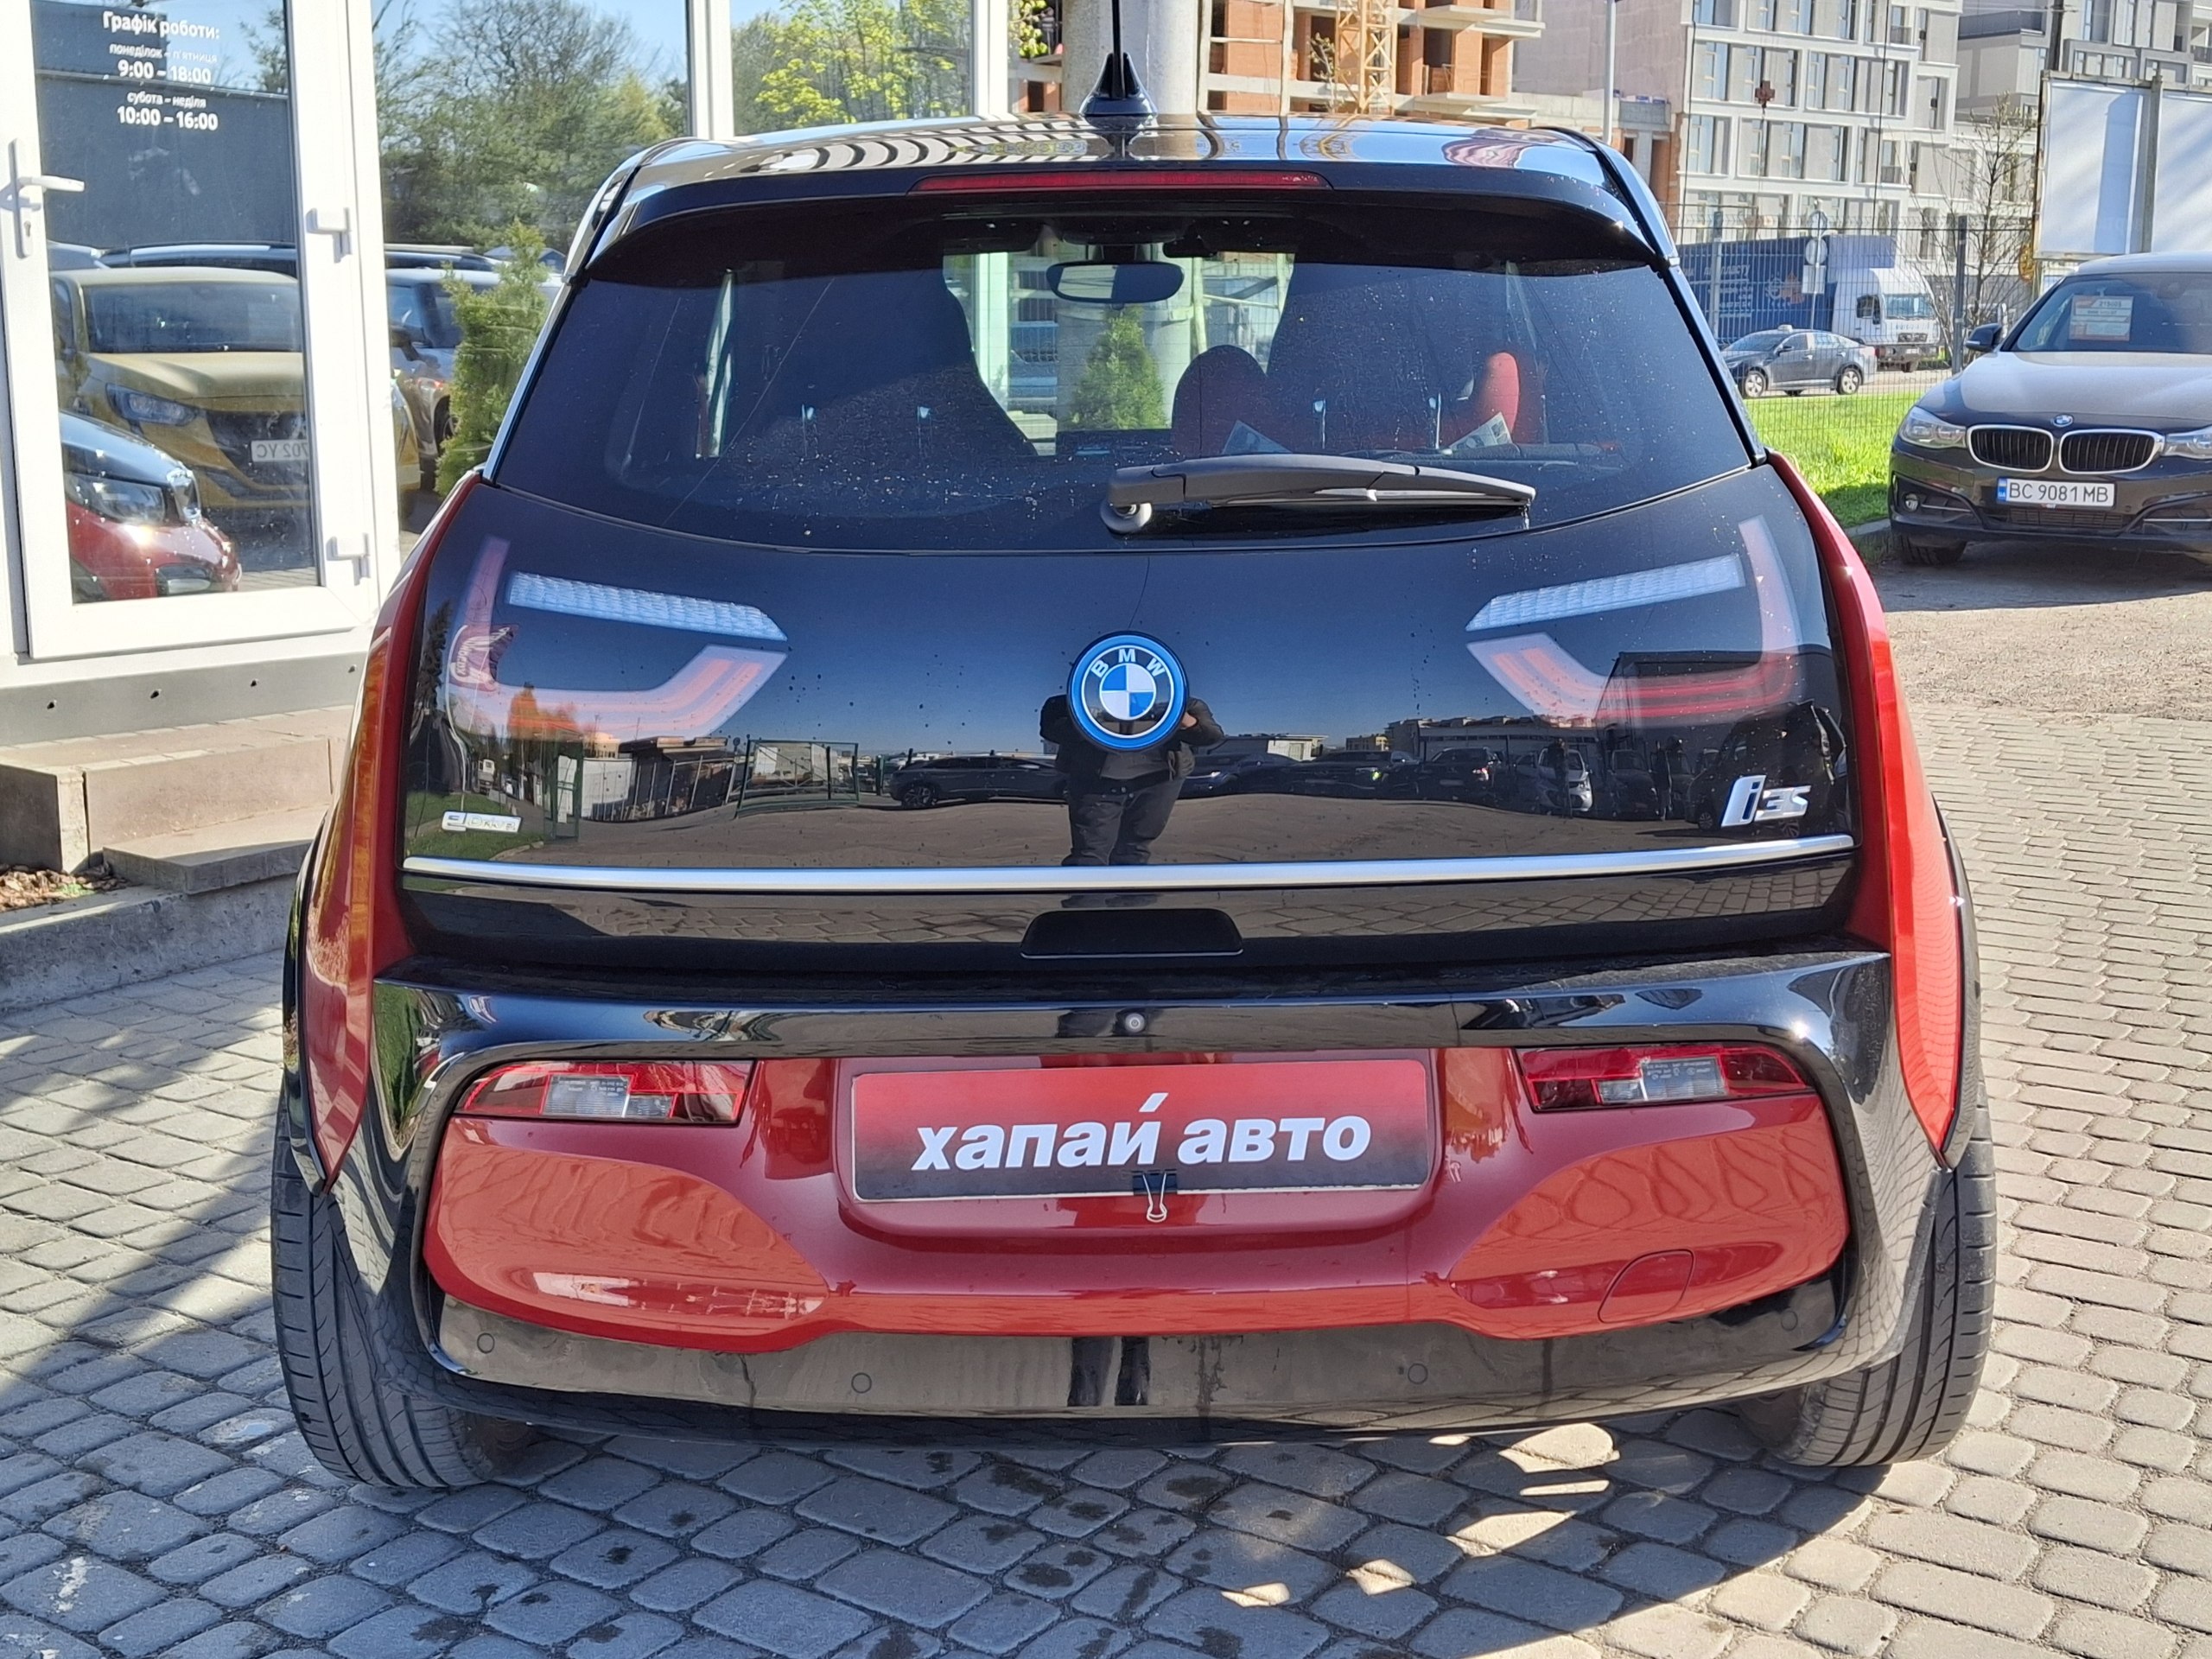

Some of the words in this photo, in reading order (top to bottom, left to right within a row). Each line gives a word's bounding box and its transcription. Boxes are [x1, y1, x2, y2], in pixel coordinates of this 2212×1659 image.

[103, 11, 157, 35] Графік
[160, 20, 220, 40] роботи:
[109, 43, 162, 59] понеділок
[173, 50, 218, 64] п'ятниця
[118, 60, 155, 79] 9:00
[171, 66, 212, 84] 18:00
[127, 91, 163, 105] субота
[173, 96, 207, 109] неділя
[117, 106, 162, 126] 10:00
[176, 111, 219, 130] 16:00
[2009, 482, 2033, 499] BC
[2038, 484, 2078, 502] 9081
[2082, 486, 2108, 503] MB
[1090, 648, 1166, 678] BMW
[1176, 1116, 1371, 1165] авто
